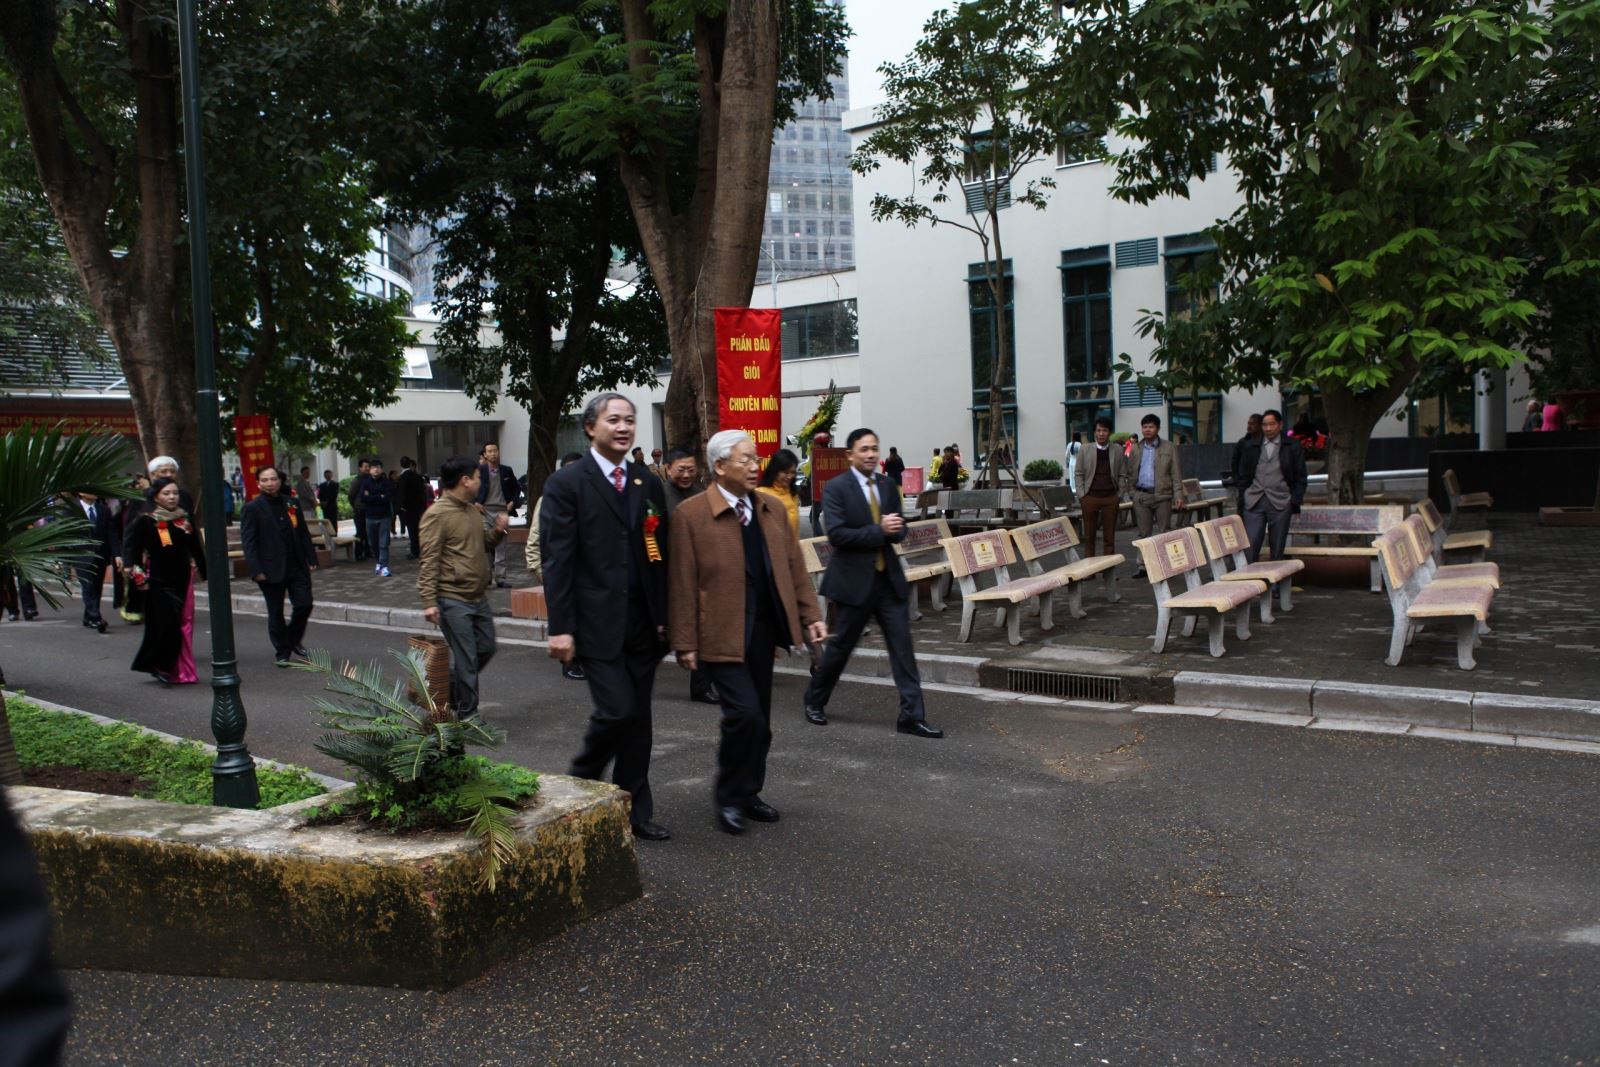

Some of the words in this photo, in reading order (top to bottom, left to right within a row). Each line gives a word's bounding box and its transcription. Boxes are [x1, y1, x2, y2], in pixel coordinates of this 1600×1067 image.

[730, 333, 752, 351] PHẤN
[754, 333, 770, 351] ĐẤU
[743, 361, 761, 380] GIỎI
[729, 395, 760, 411] CHUYÊN
[757, 429, 778, 443] DANH
